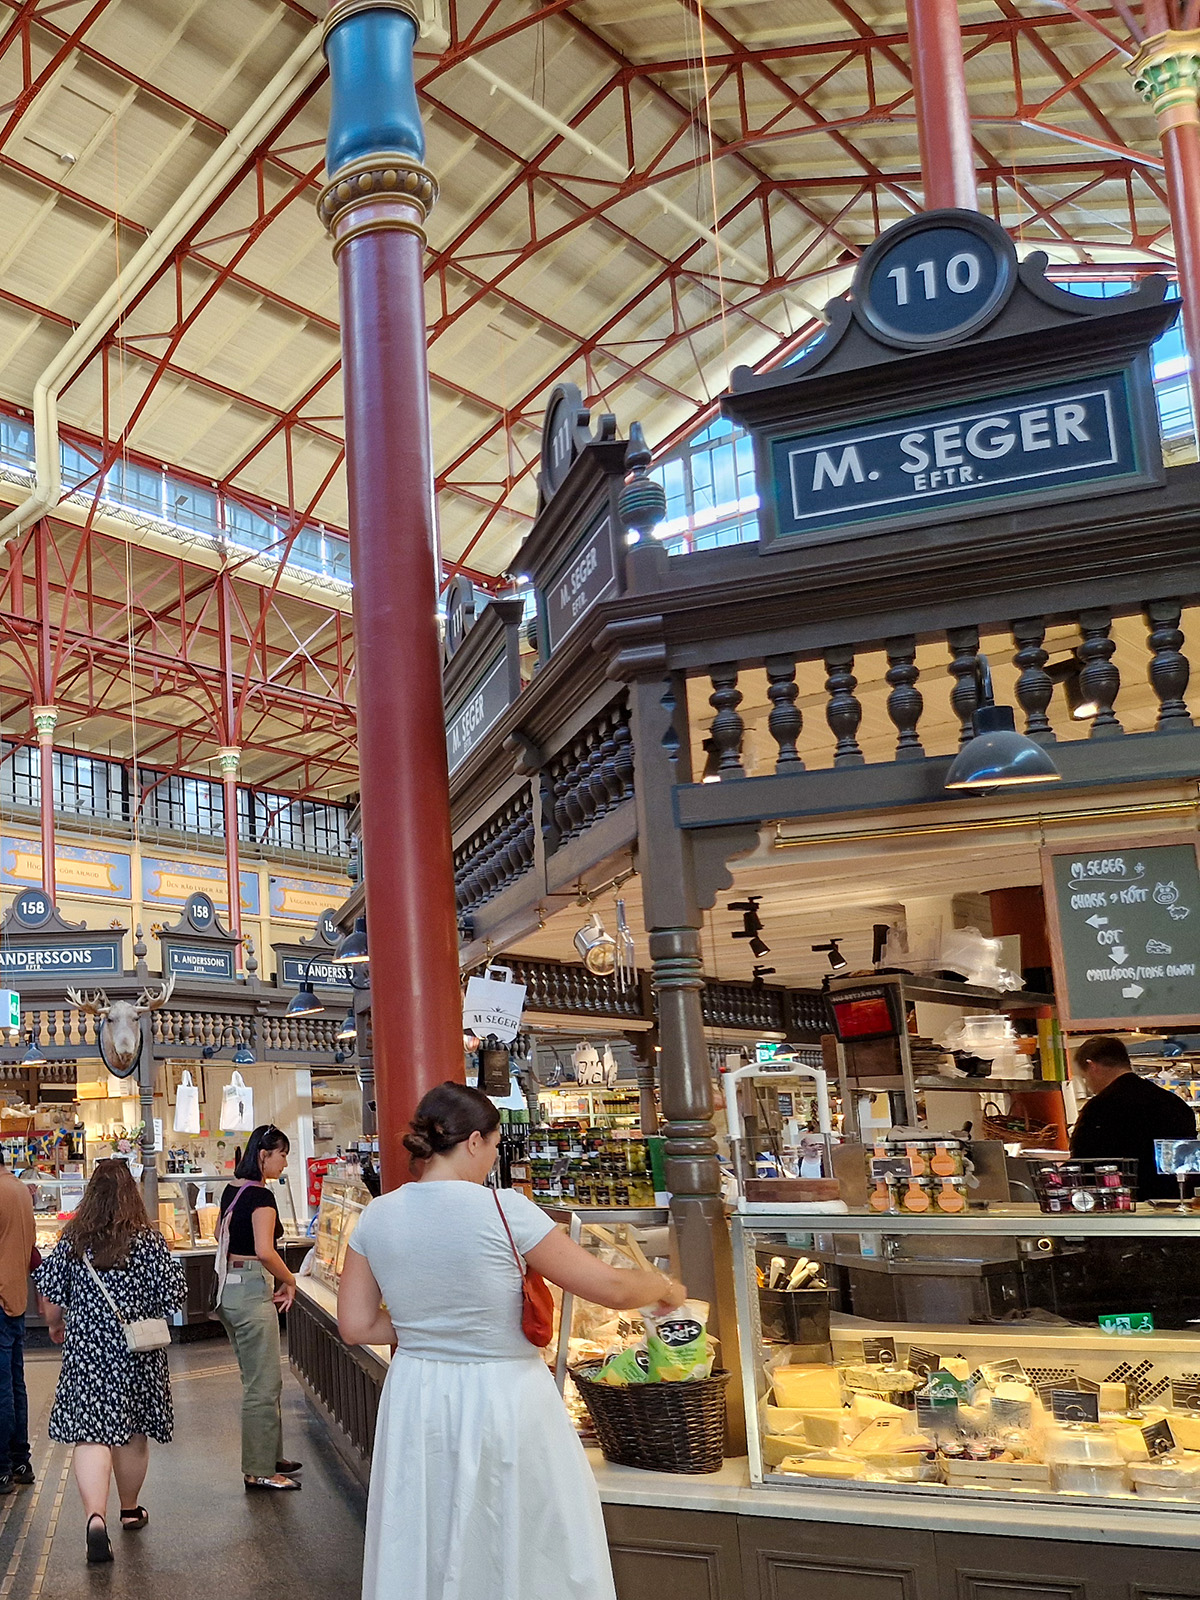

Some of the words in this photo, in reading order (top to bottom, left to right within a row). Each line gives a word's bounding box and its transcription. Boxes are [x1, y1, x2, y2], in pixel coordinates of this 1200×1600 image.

[886, 252, 980, 306] 110
[552, 418, 571, 468] 111
[812, 445, 880, 491] M.
[899, 404, 1090, 474] SEGER
[914, 465, 984, 491] EFTR.
[560, 583, 571, 611] M.
[570, 547, 598, 596] SEGER
[571, 591, 587, 617] EFTR.
[452, 603, 463, 638] 111
[452, 727, 462, 754] M.
[461, 693, 485, 741] SEGER
[20, 901, 45, 914] 158
[1070, 891, 1107, 910] CHARK
[1120, 885, 1149, 904] KÖTT
[192, 905, 209, 918] 158
[1096, 929, 1124, 946] OST
[174, 954, 181, 964] B.
[181, 956, 225, 968] ANDERSSONS
[297, 963, 306, 976] B.
[1166, 963, 1196, 977] AWAY
[473, 1014, 482, 1023] M
[485, 1015, 518, 1030] SEGER
[659, 1323, 700, 1343] Brets
